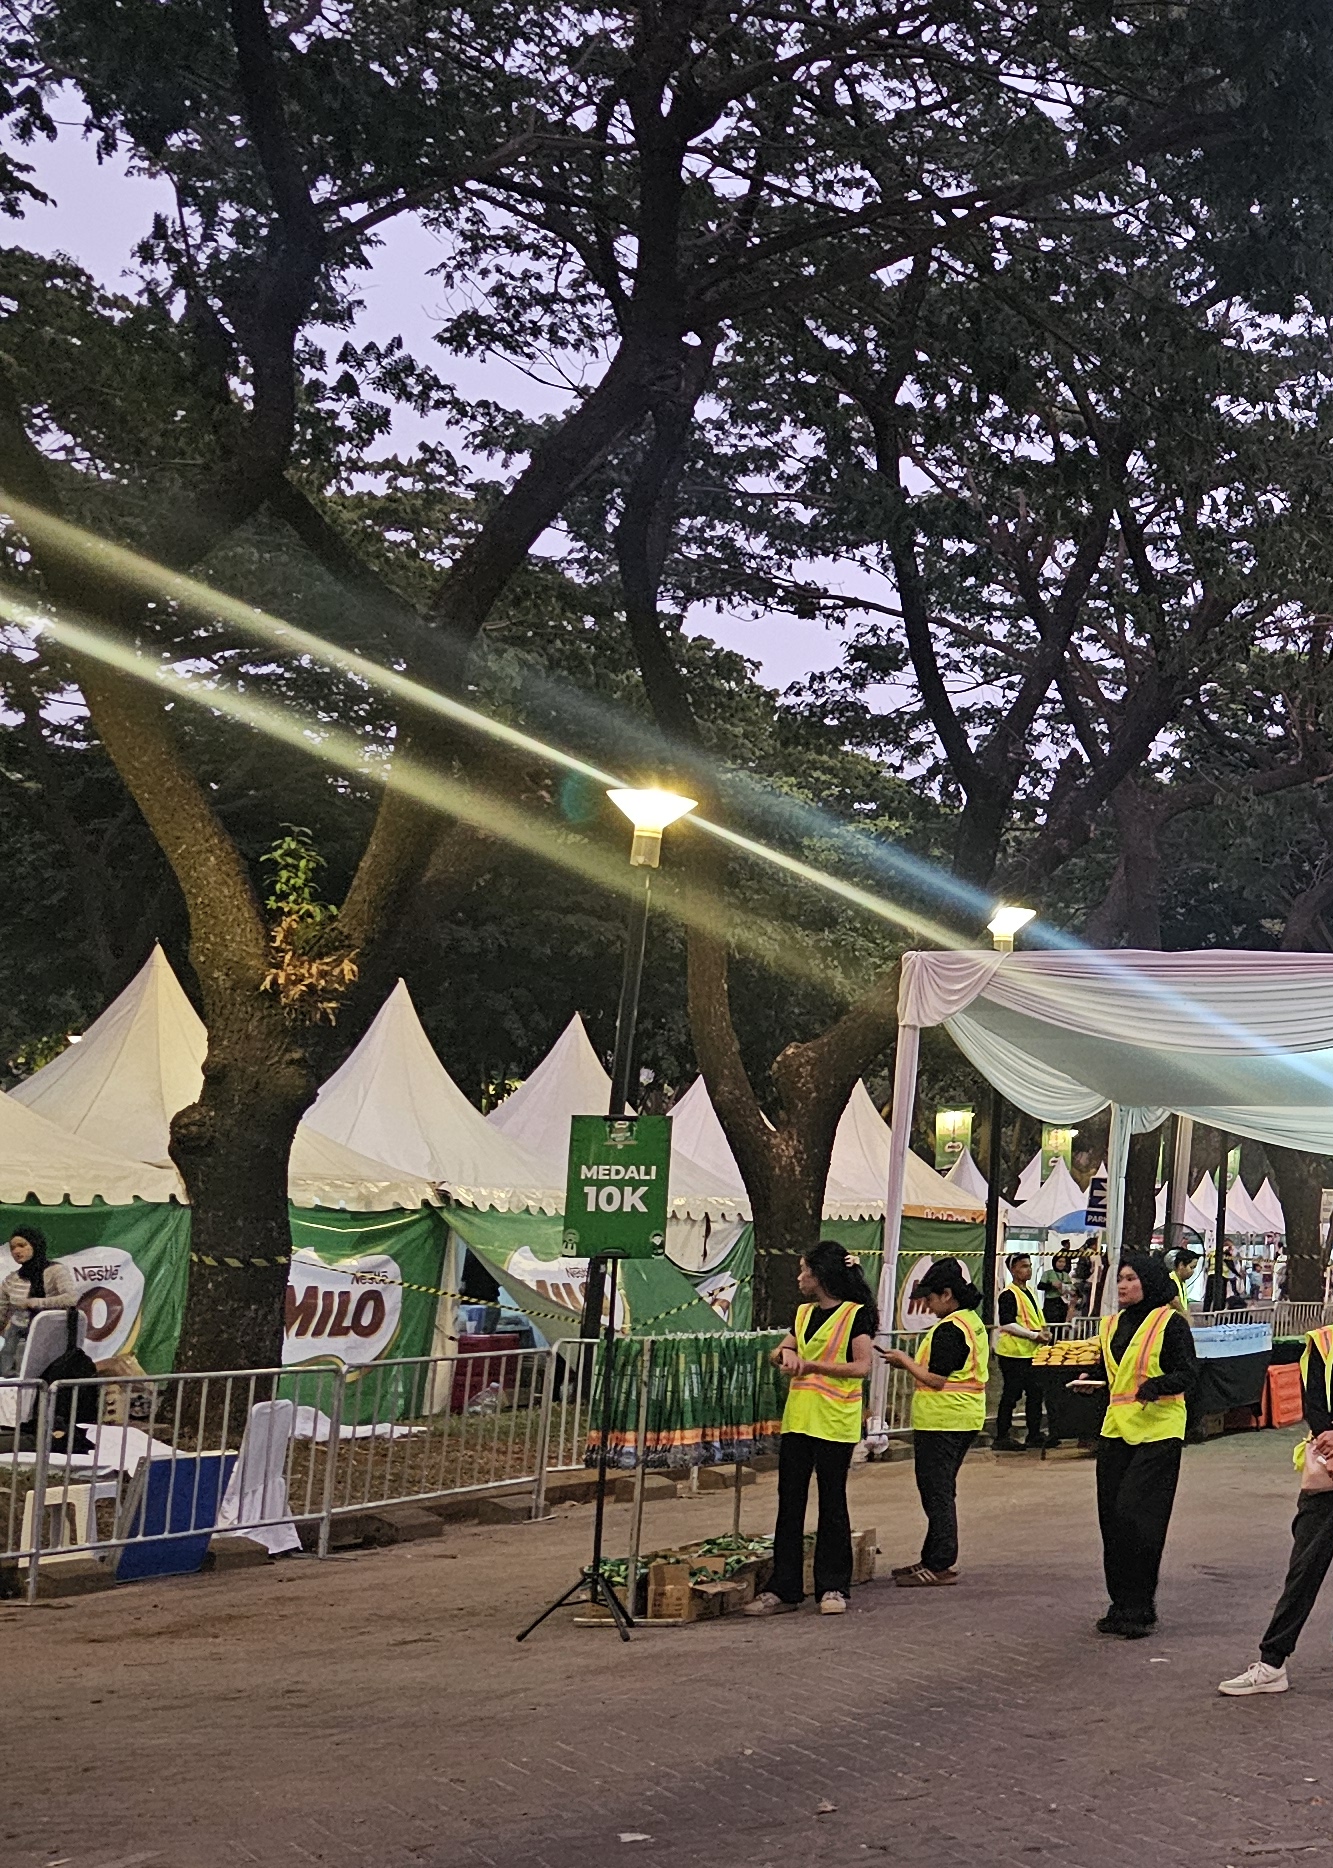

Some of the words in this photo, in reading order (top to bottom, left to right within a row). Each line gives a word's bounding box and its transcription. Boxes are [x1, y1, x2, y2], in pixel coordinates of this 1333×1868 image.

[581, 1165, 657, 1179] MEDALI
[583, 1186, 649, 1212] 10K
[285, 1284, 386, 1339] MILO
